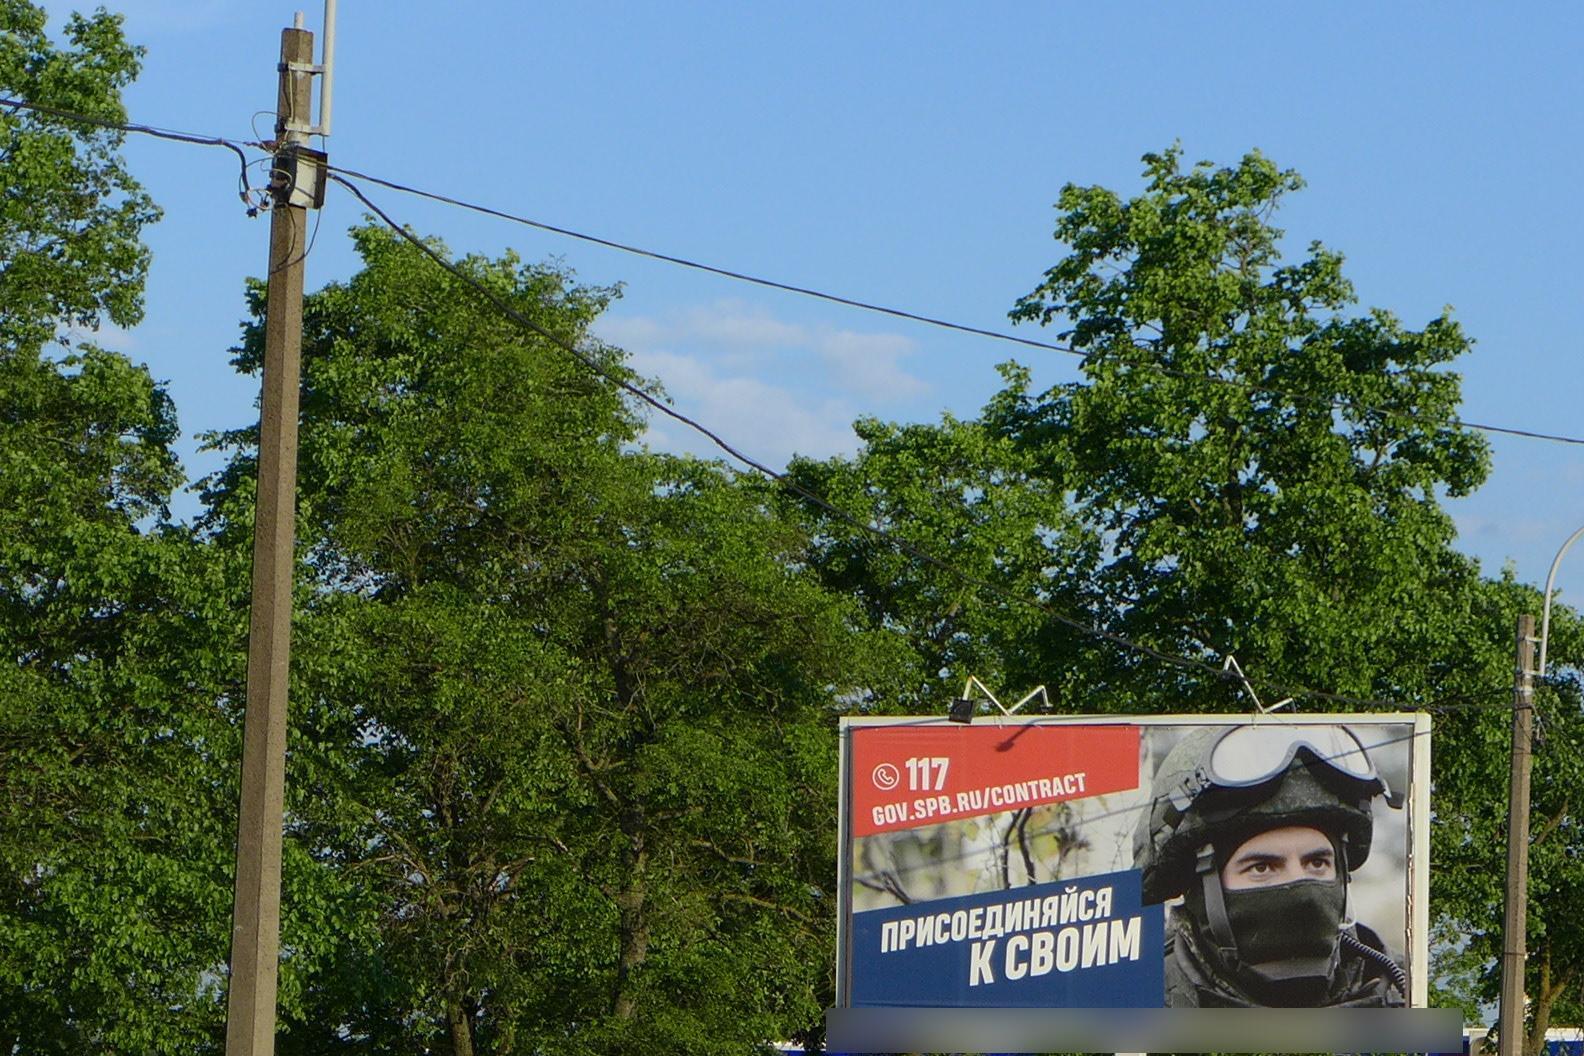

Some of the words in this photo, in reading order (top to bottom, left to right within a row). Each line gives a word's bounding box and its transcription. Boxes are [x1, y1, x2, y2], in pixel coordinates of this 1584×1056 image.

[871, 772, 1086, 827] GOV.SPB.RU/CONTRACT
[905, 757, 950, 792] 117
[880, 886, 1113, 953] ПРИСОЕДИНЯЙСЯ
[969, 940, 995, 987] К
[1005, 917, 1142, 981] СВОИМ
